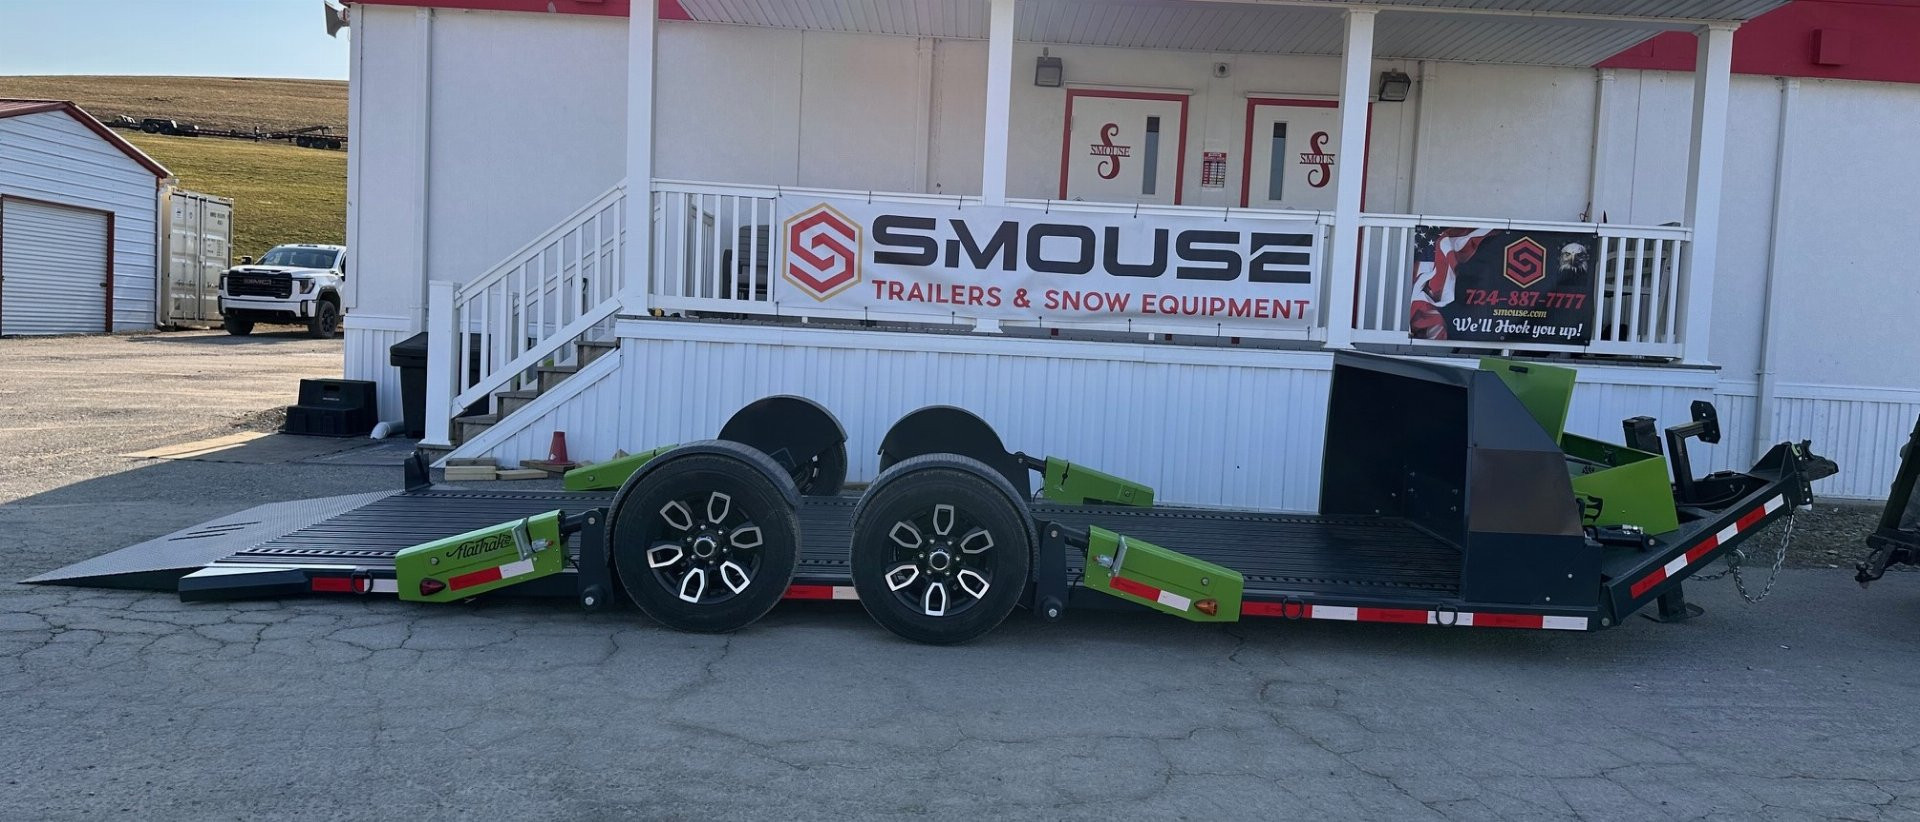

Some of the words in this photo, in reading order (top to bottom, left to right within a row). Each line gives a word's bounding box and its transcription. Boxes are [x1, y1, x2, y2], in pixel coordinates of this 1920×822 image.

[1090, 145, 1130, 157] SMOUSE
[1300, 154, 1335, 165] SMOUS
[872, 214, 1313, 284] SMOUSE
[872, 279, 1002, 307] TRAILERS
[1013, 288, 1031, 308] &
[1044, 289, 1131, 313] SNOW
[1141, 293, 1310, 320] EQUIPMENT
[1465, 289, 1587, 309] 724-887-7777
[1493, 308, 1547, 318] smouse.com
[1453, 317, 1492, 333] We'll
[1494, 319, 1530, 334] Hook
[1532, 324, 1556, 338] you
[1560, 323, 1583, 340] up!
